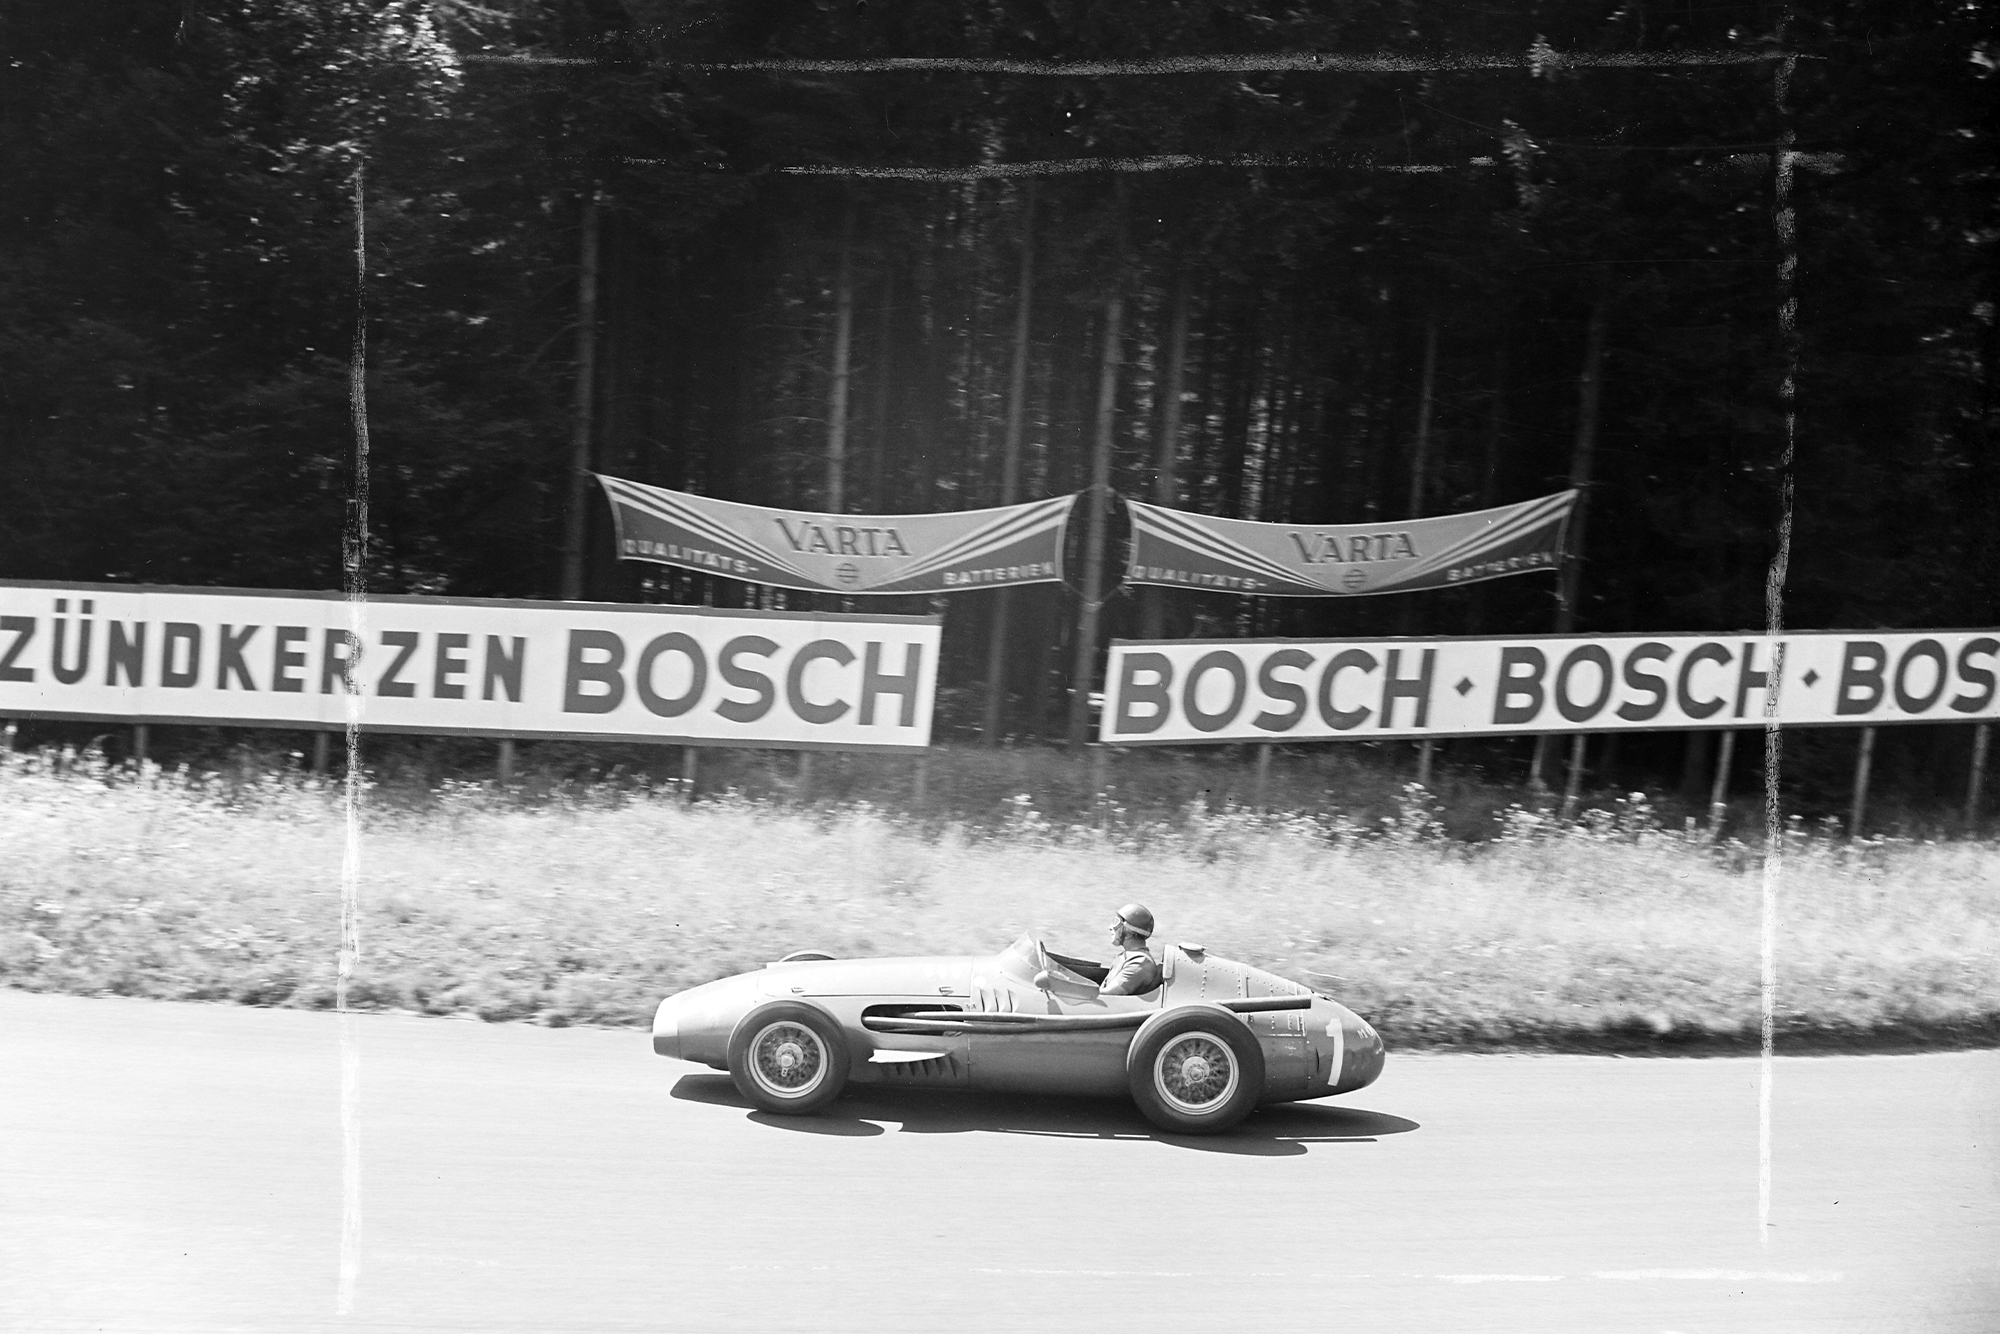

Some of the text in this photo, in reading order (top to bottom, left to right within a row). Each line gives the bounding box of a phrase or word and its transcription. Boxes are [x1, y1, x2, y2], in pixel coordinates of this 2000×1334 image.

[772, 517, 913, 558] VARTA
[1287, 531, 1421, 564] VARTA
[0, 598, 924, 728] ZÜNDKERZEN BOSCH
[1114, 637, 2000, 735] BOSCH BOSCH BOS
[1325, 1018, 1344, 1087] 1
